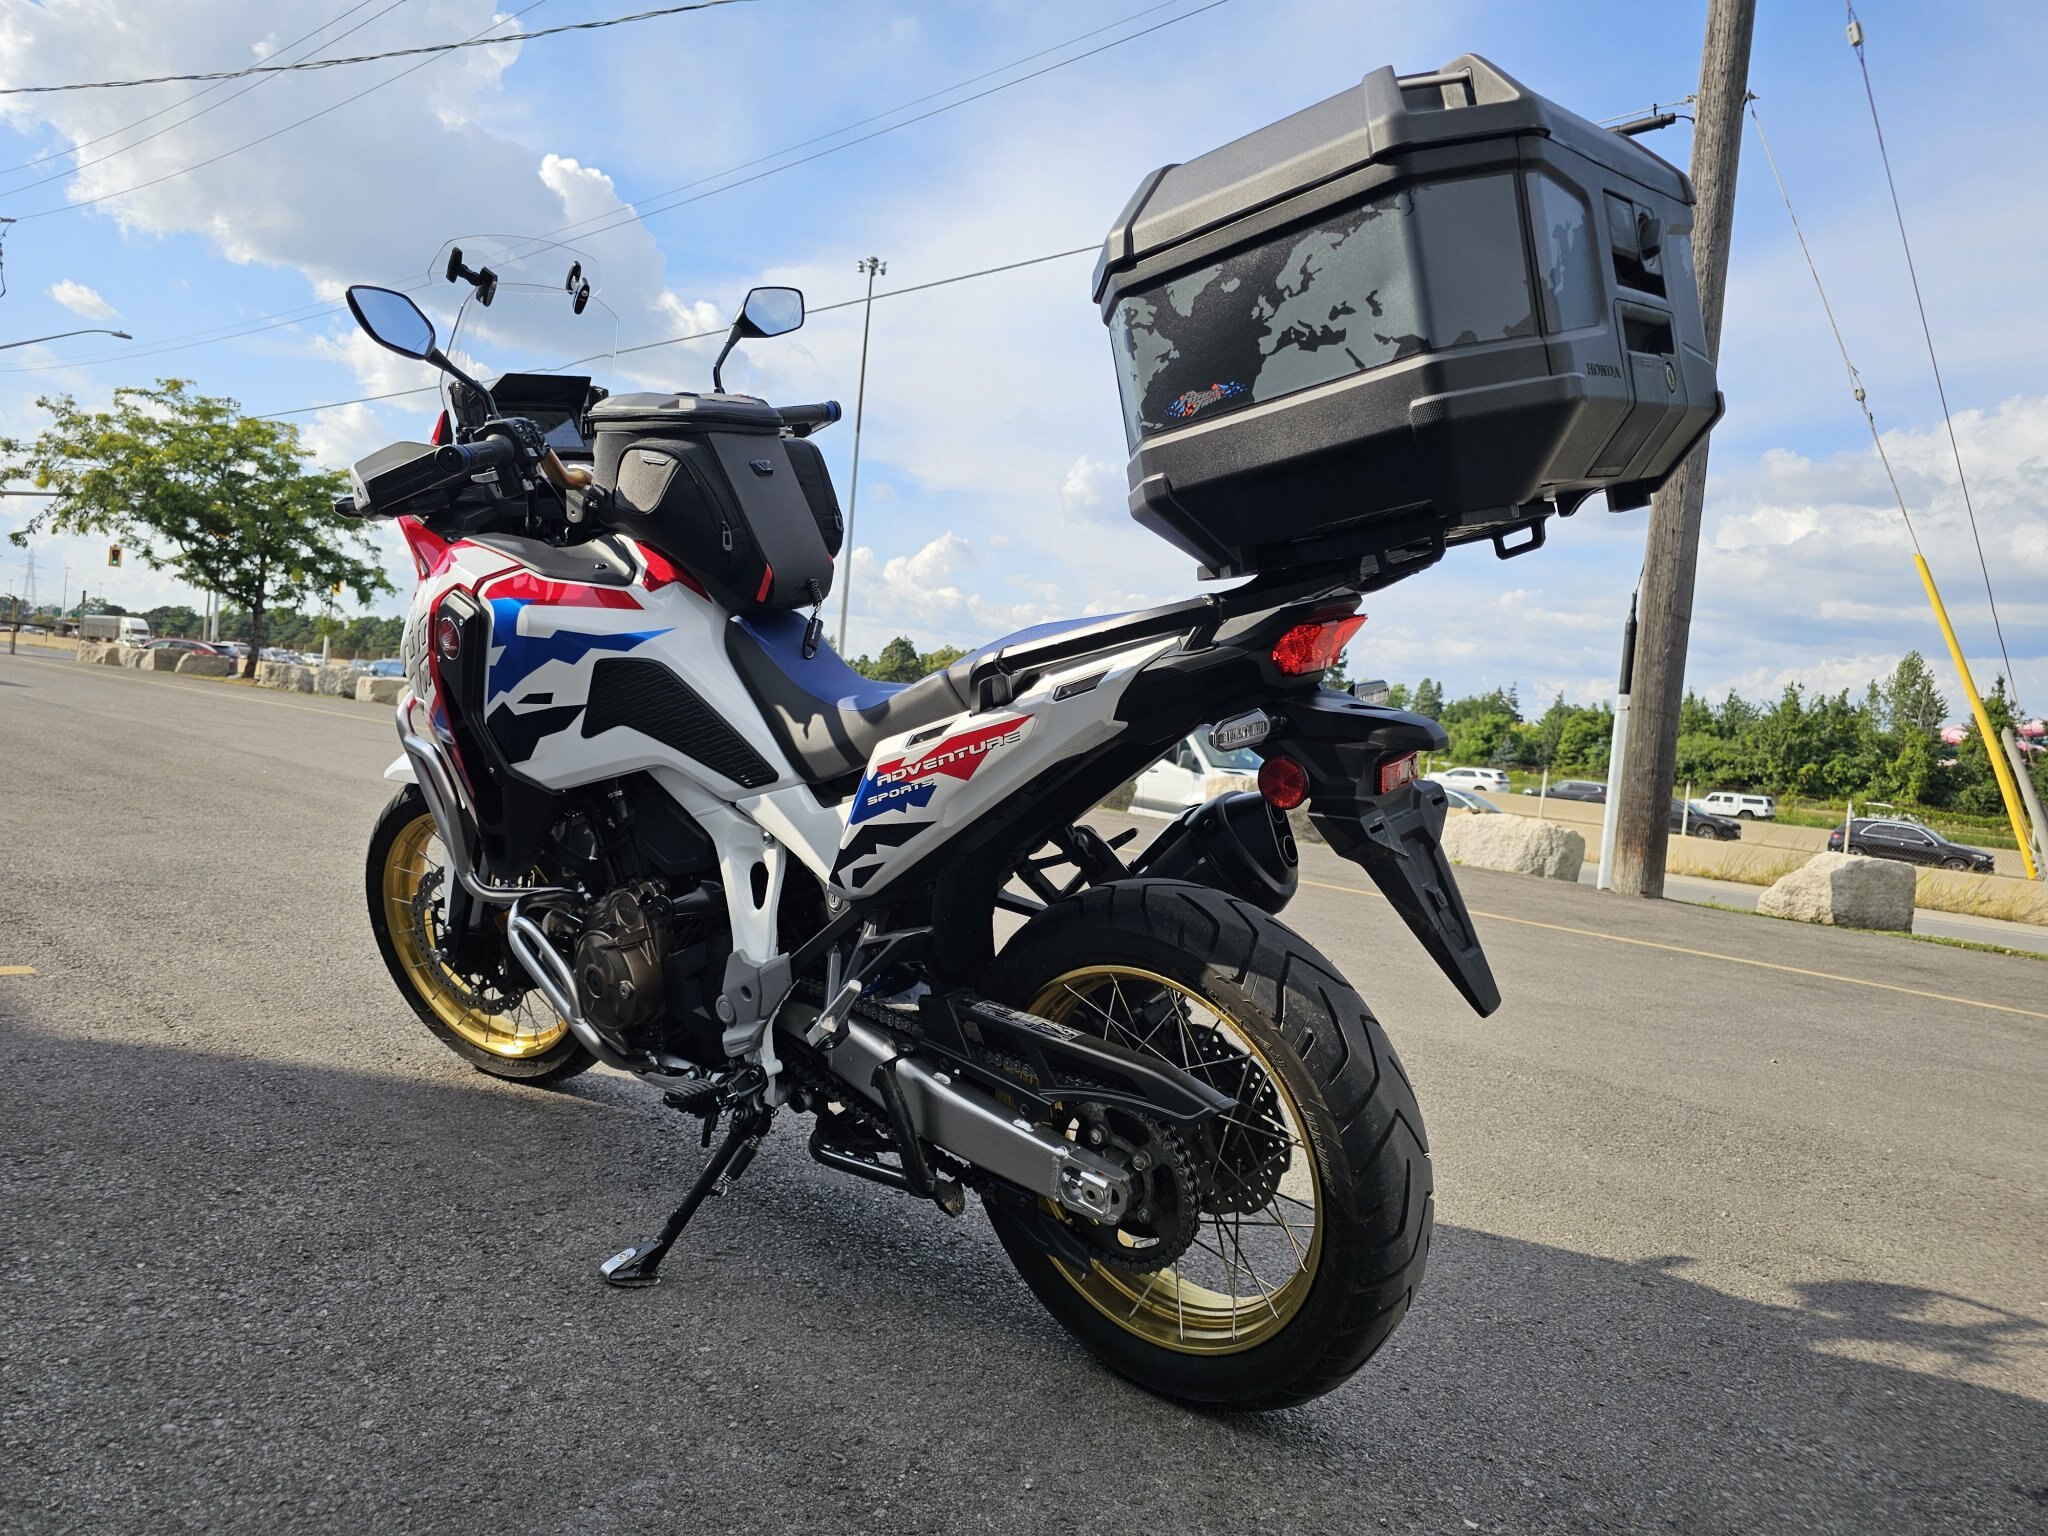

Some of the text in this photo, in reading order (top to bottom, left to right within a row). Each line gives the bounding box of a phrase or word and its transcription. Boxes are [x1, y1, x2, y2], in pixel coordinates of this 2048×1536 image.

[1586, 362, 1622, 378] HONDA
[876, 731, 1021, 787] ADVENTURE
[867, 778, 935, 806] SPORTS
